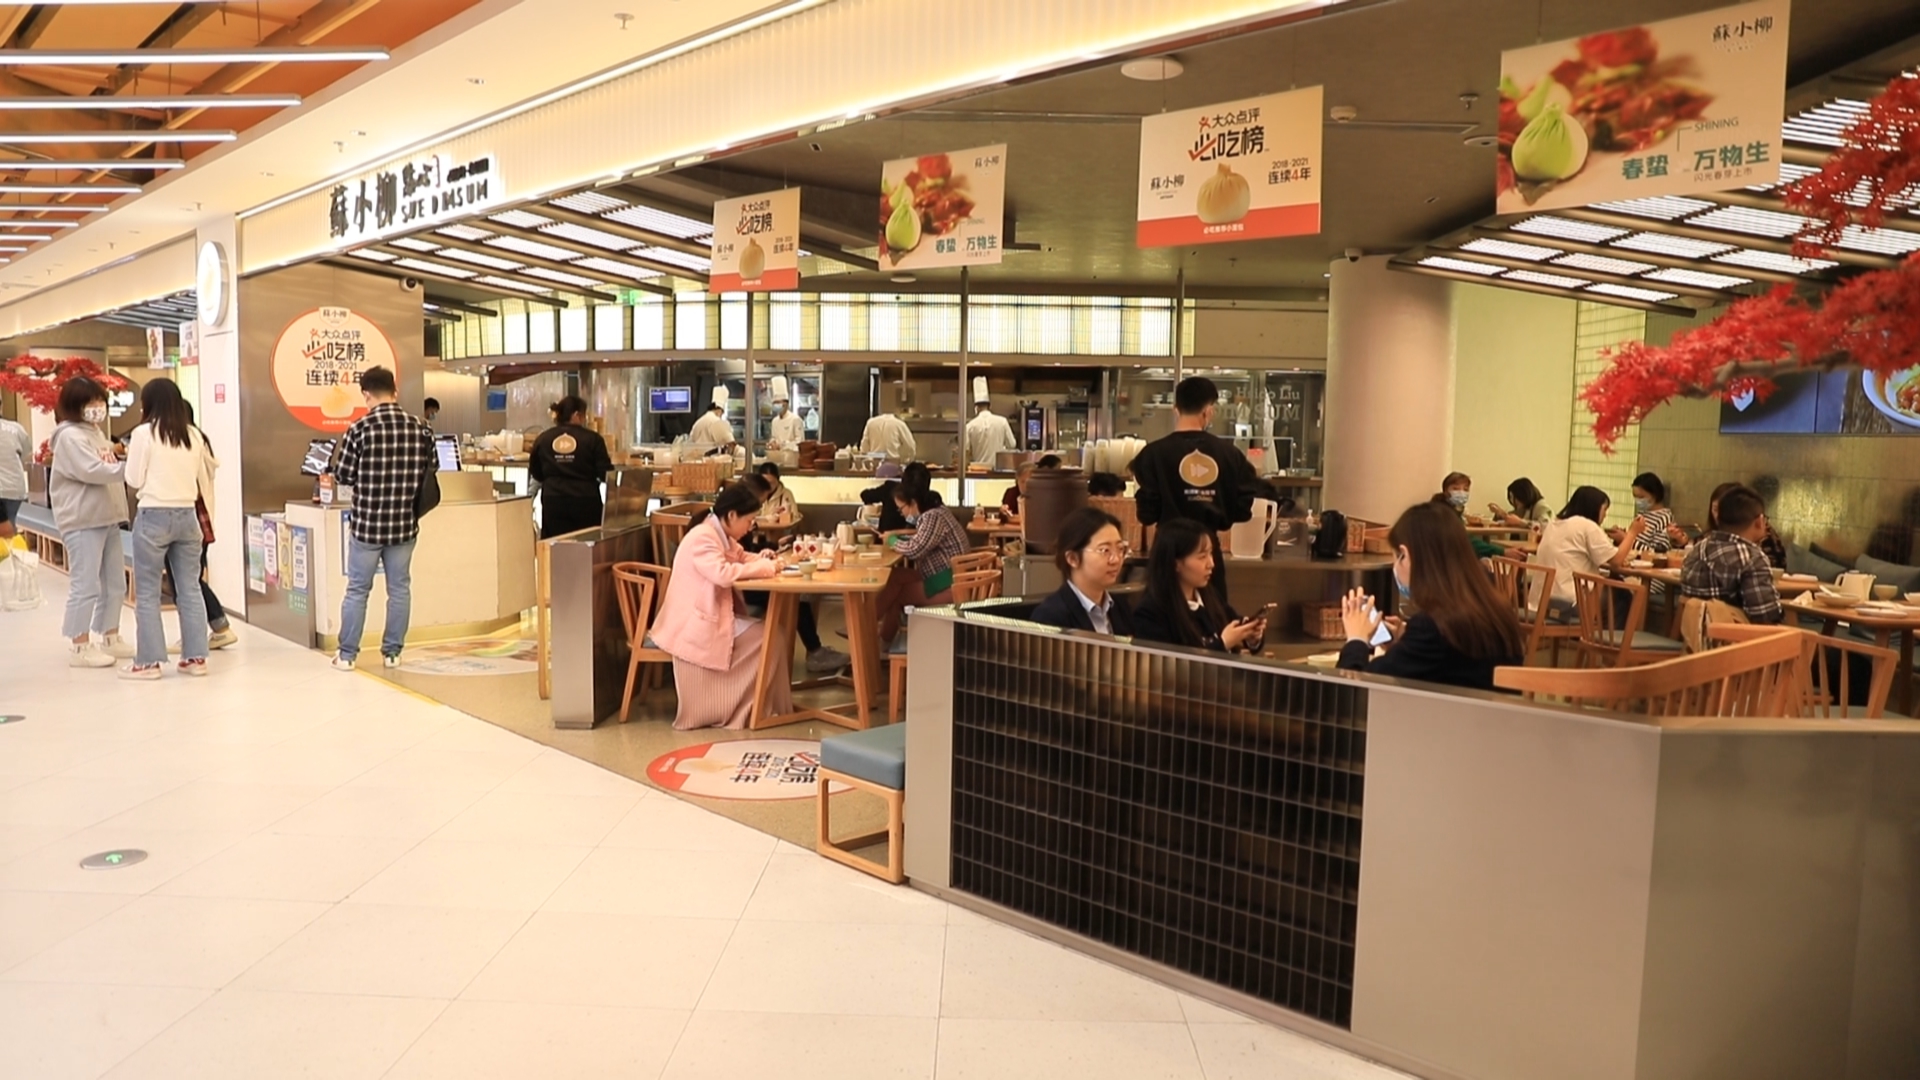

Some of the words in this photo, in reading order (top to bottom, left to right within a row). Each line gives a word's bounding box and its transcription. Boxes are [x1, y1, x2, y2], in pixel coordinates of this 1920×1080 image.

[1212, 107, 1261, 129] 大众点评
[1695, 117, 1739, 132] SHINING
[1188, 125, 1265, 162] 必吃榜
[1694, 140, 1770, 172] 万物生
[1268, 167, 1312, 186] 连续4年
[736, 212, 773, 235] 必吃榜
[966, 235, 998, 251] 万物生
[321, 329, 361, 340] 大众点评
[302, 340, 365, 362] 必吃榜
[1280, 385, 1300, 400] Liu
[1254, 403, 1300, 420] SUM
